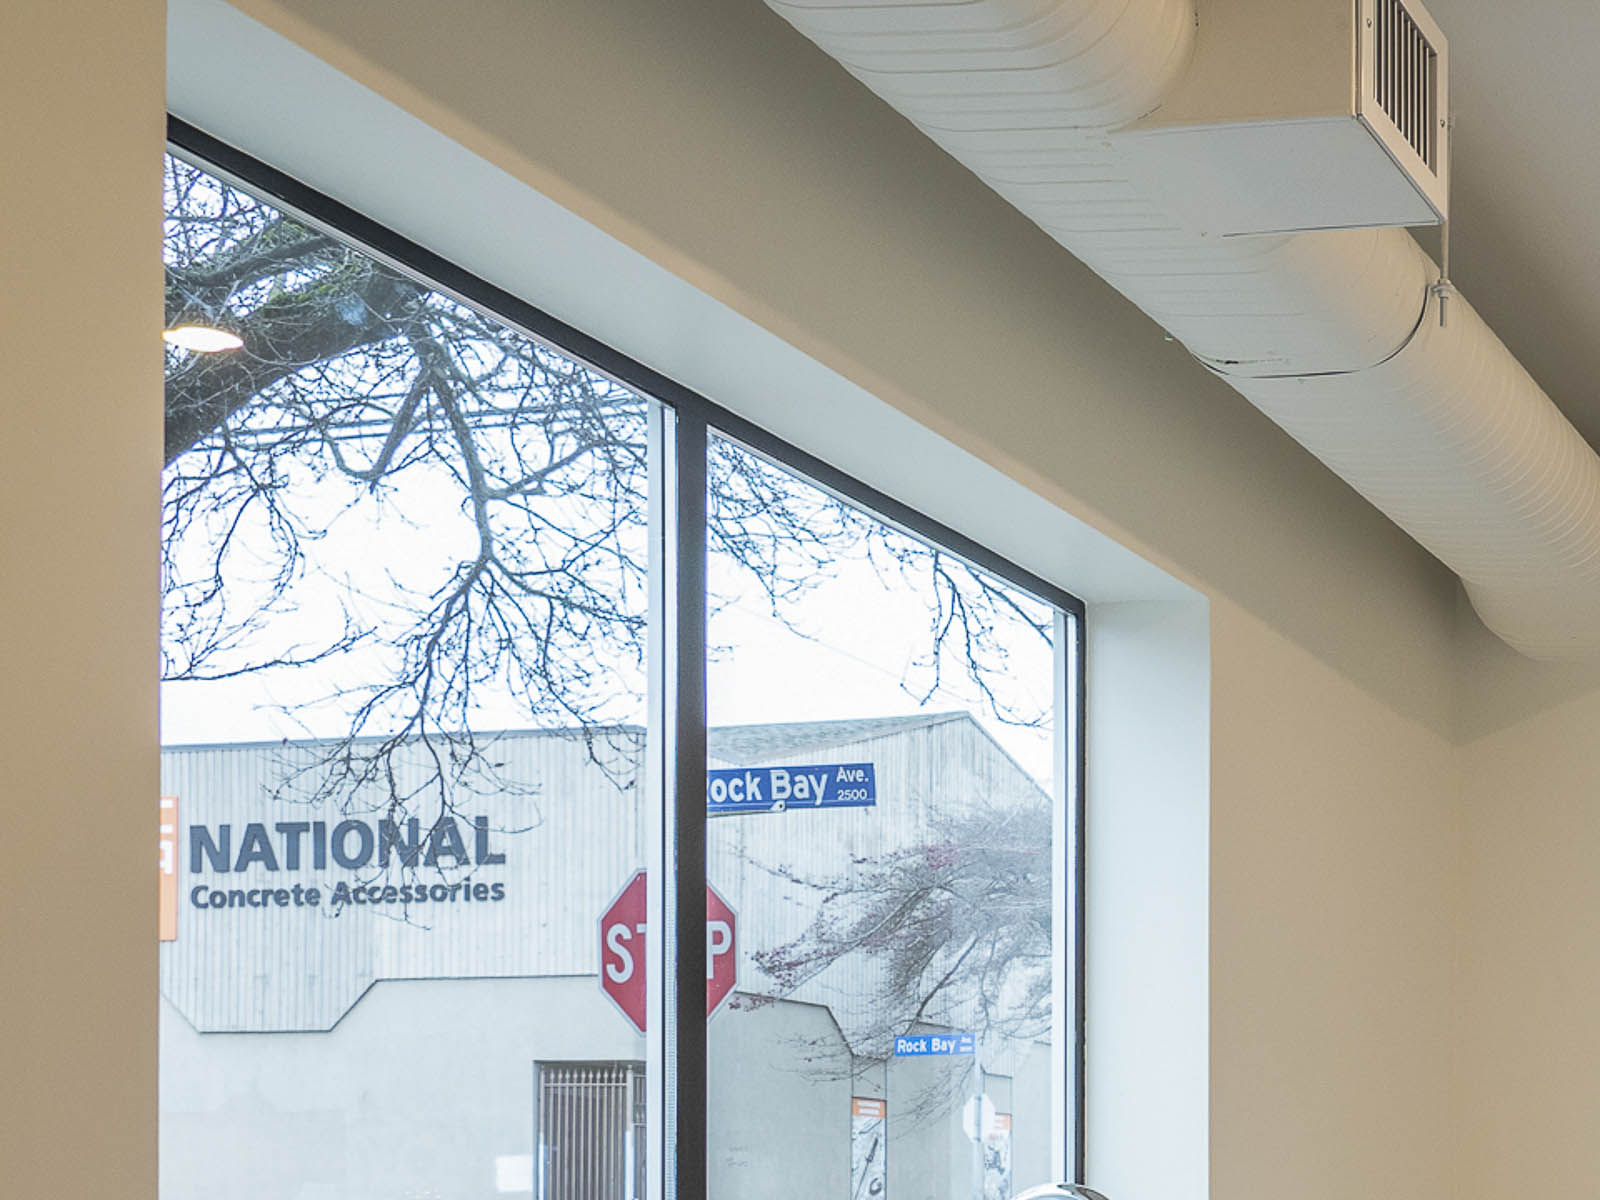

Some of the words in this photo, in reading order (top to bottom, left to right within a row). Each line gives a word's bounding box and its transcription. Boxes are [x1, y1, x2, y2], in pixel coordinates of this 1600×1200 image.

[707, 771, 762, 803] ock
[770, 769, 828, 806] Bay
[836, 766, 869, 783] Ave.
[837, 788, 868, 800] 2500
[189, 816, 506, 873] NATIONAL
[190, 883, 321, 909] Concrete
[331, 877, 506, 905] Accessories
[606, 920, 733, 984] SP
[897, 1038, 928, 1053] Rock
[931, 1037, 957, 1054] Bay
